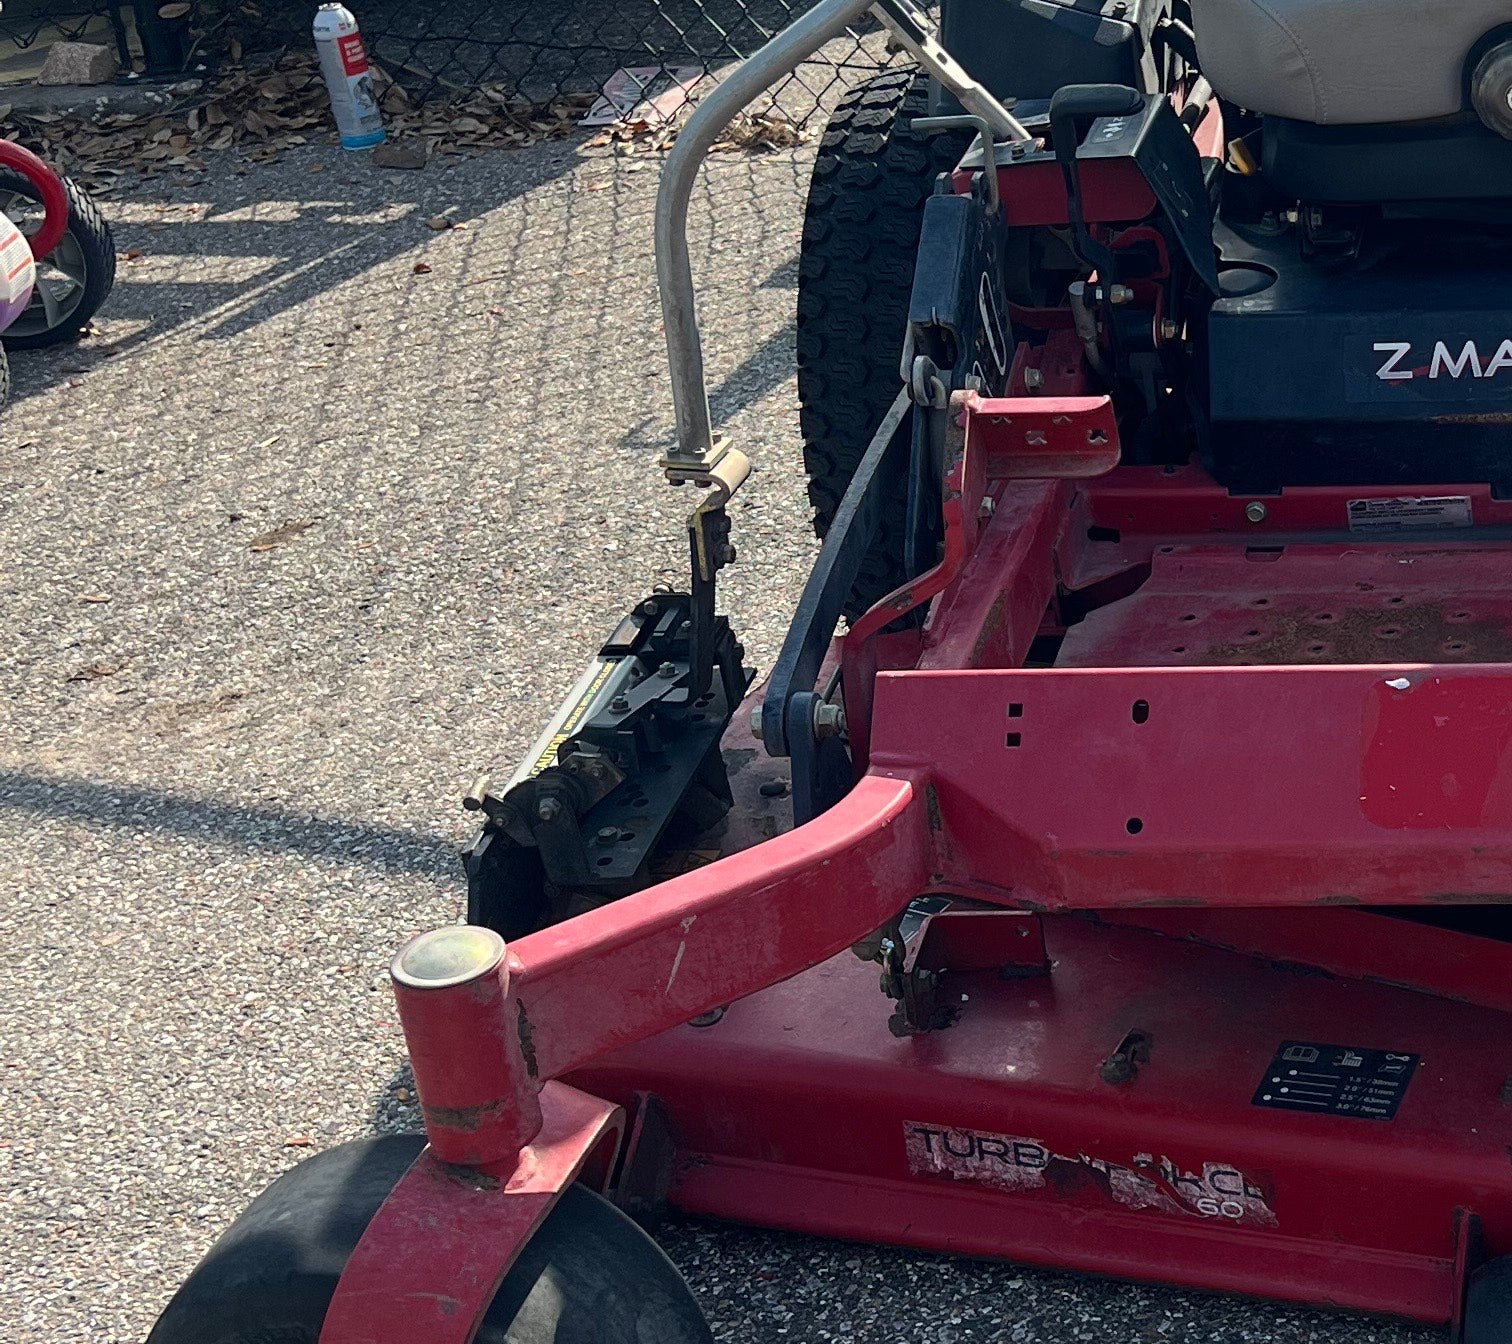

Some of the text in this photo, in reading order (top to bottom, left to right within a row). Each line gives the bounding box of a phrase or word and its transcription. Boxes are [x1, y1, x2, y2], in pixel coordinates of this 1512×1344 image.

[1372, 341, 1414, 380] Z
[529, 732, 570, 776] CAUTION
[1197, 1197, 1244, 1219] 60
